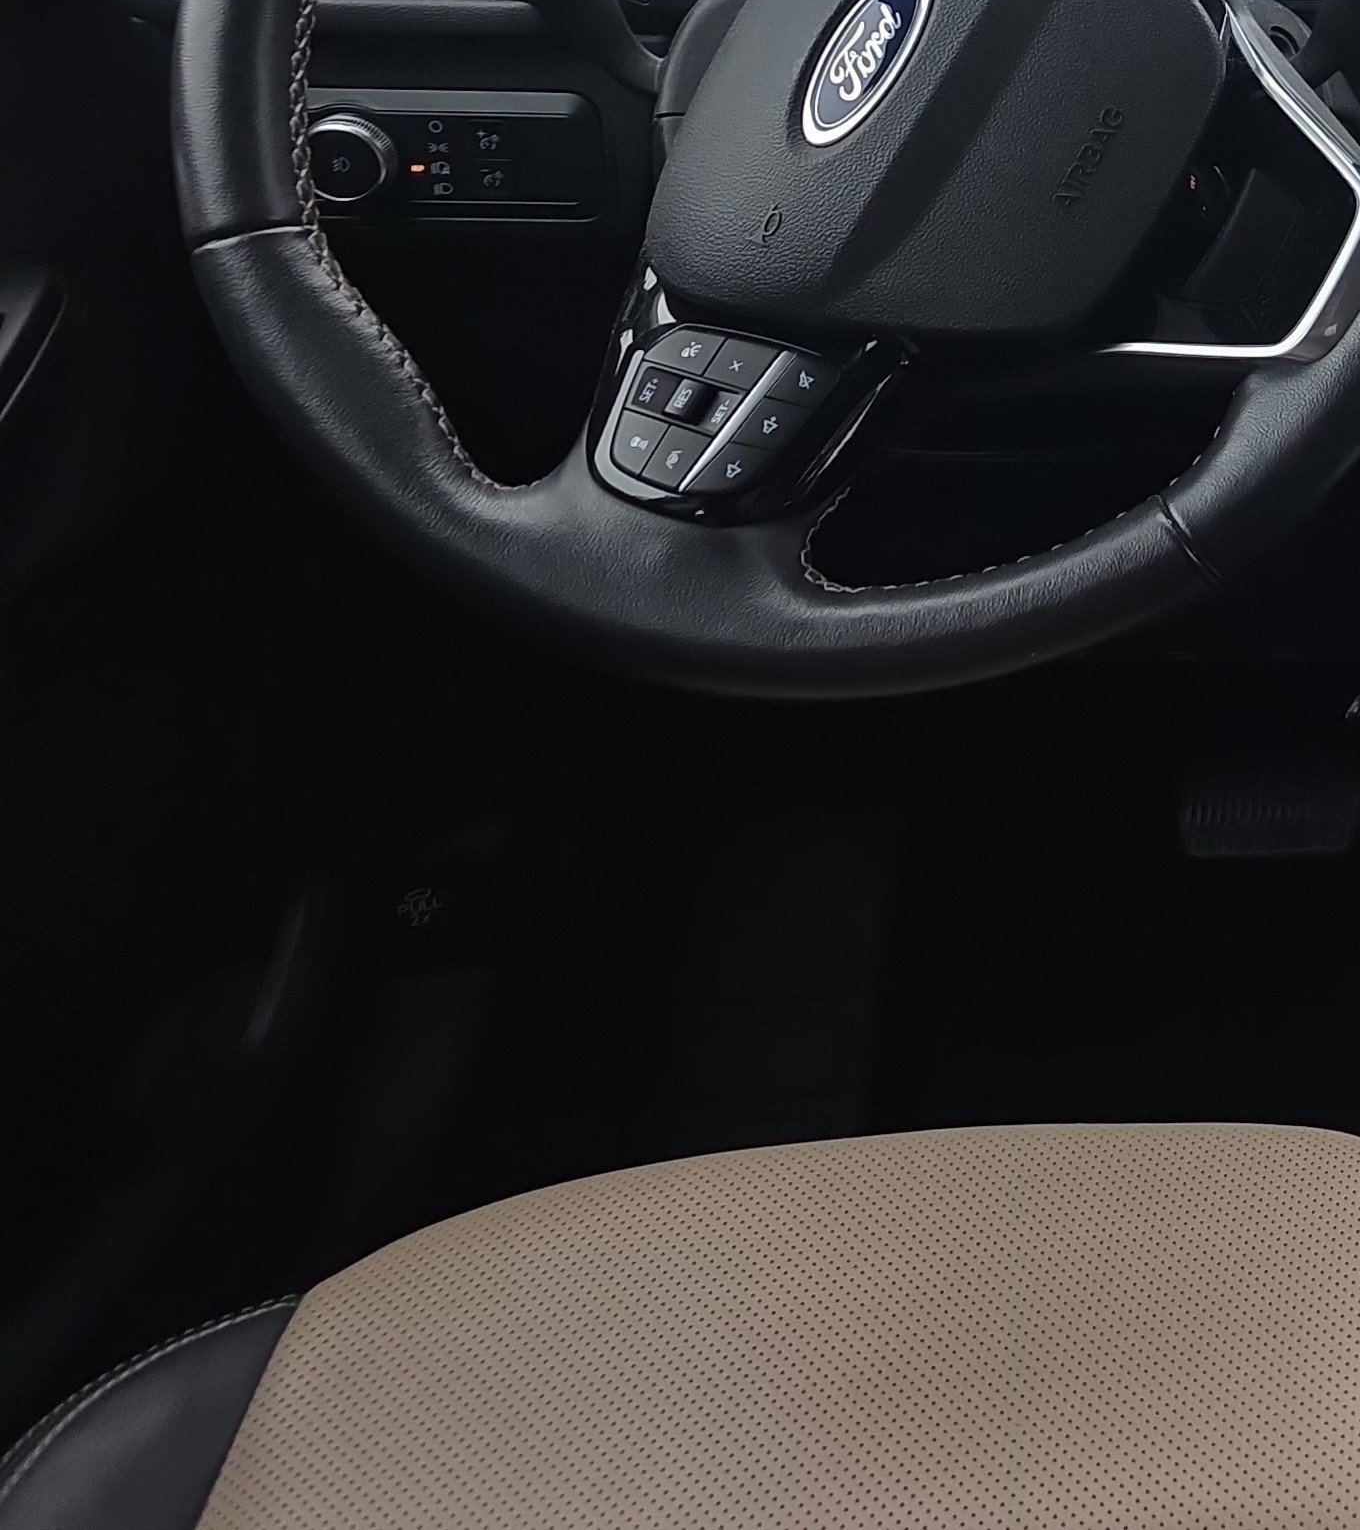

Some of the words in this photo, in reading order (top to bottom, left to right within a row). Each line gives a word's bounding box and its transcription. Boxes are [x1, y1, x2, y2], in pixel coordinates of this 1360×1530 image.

[828, 1, 901, 102] Ford
[638, 377, 659, 404] SET+
[673, 387, 693, 409] RES
